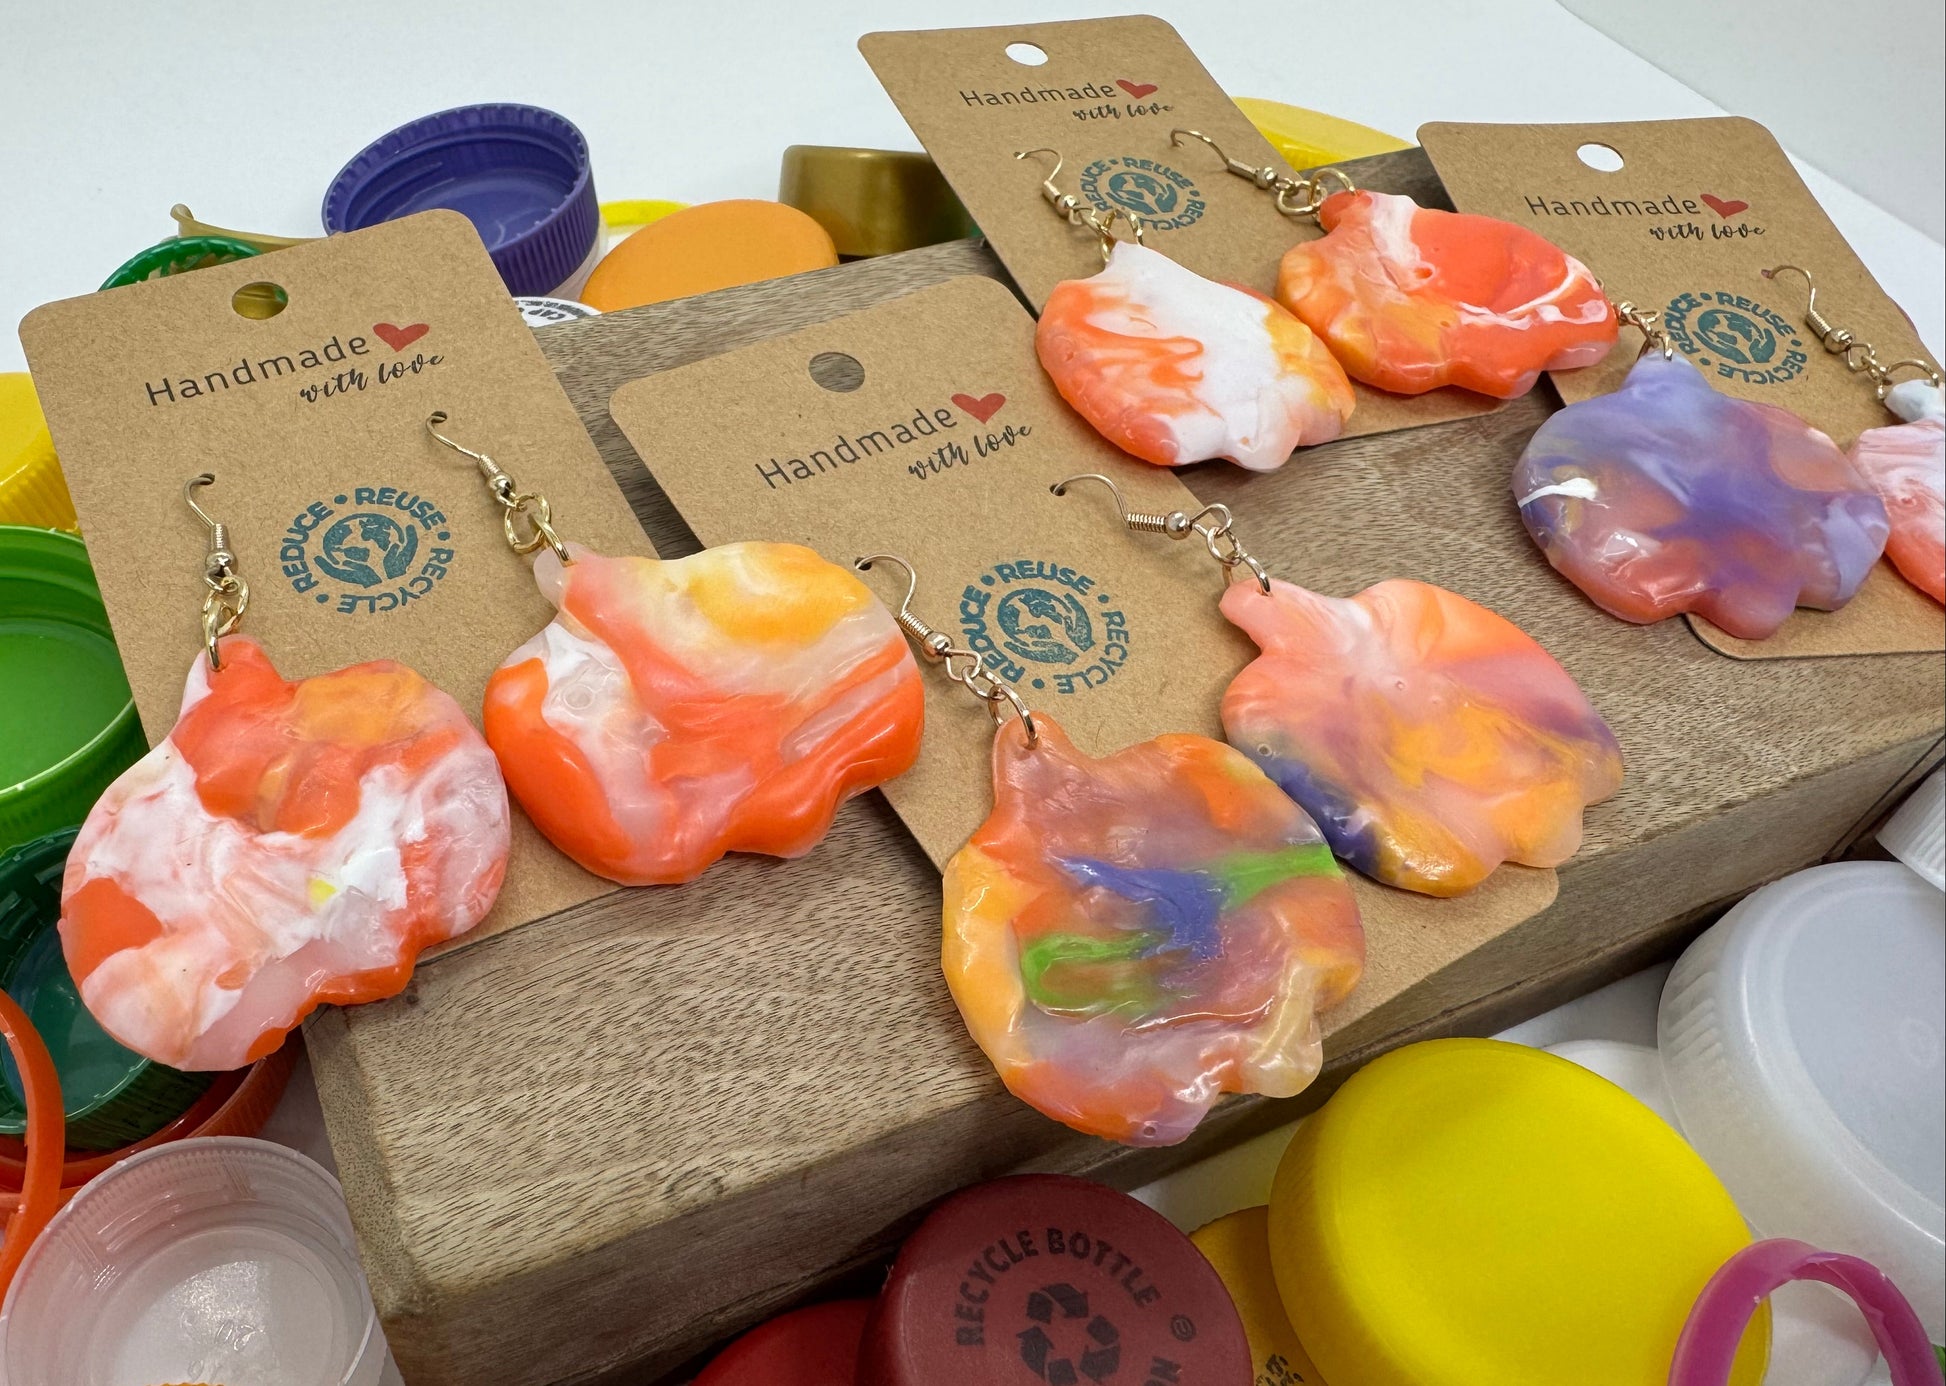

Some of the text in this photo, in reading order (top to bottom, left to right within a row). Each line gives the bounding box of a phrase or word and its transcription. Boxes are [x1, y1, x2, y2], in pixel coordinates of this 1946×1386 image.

[959, 82, 1117, 107] Handmade
[1072, 102, 1174, 121] with love
[1080, 156, 1206, 231] REDUCE REUSE RECYCL
[1524, 194, 1702, 216] Handmade
[1649, 222, 1766, 241] with love
[145, 335, 370, 407] Handmade
[1664, 291, 1808, 385] REDUCE REUSE RECYCLE
[299, 353, 445, 403] with love
[755, 407, 958, 490] Handmade
[908, 424, 1032, 480] with love
[280, 487, 455, 614] REDUCE REUSE RECYCLE
[960, 560, 1130, 694] REDUCE REUSE RECYCLE
[954, 1228, 1162, 1345] RECYCLE BOTTLE
